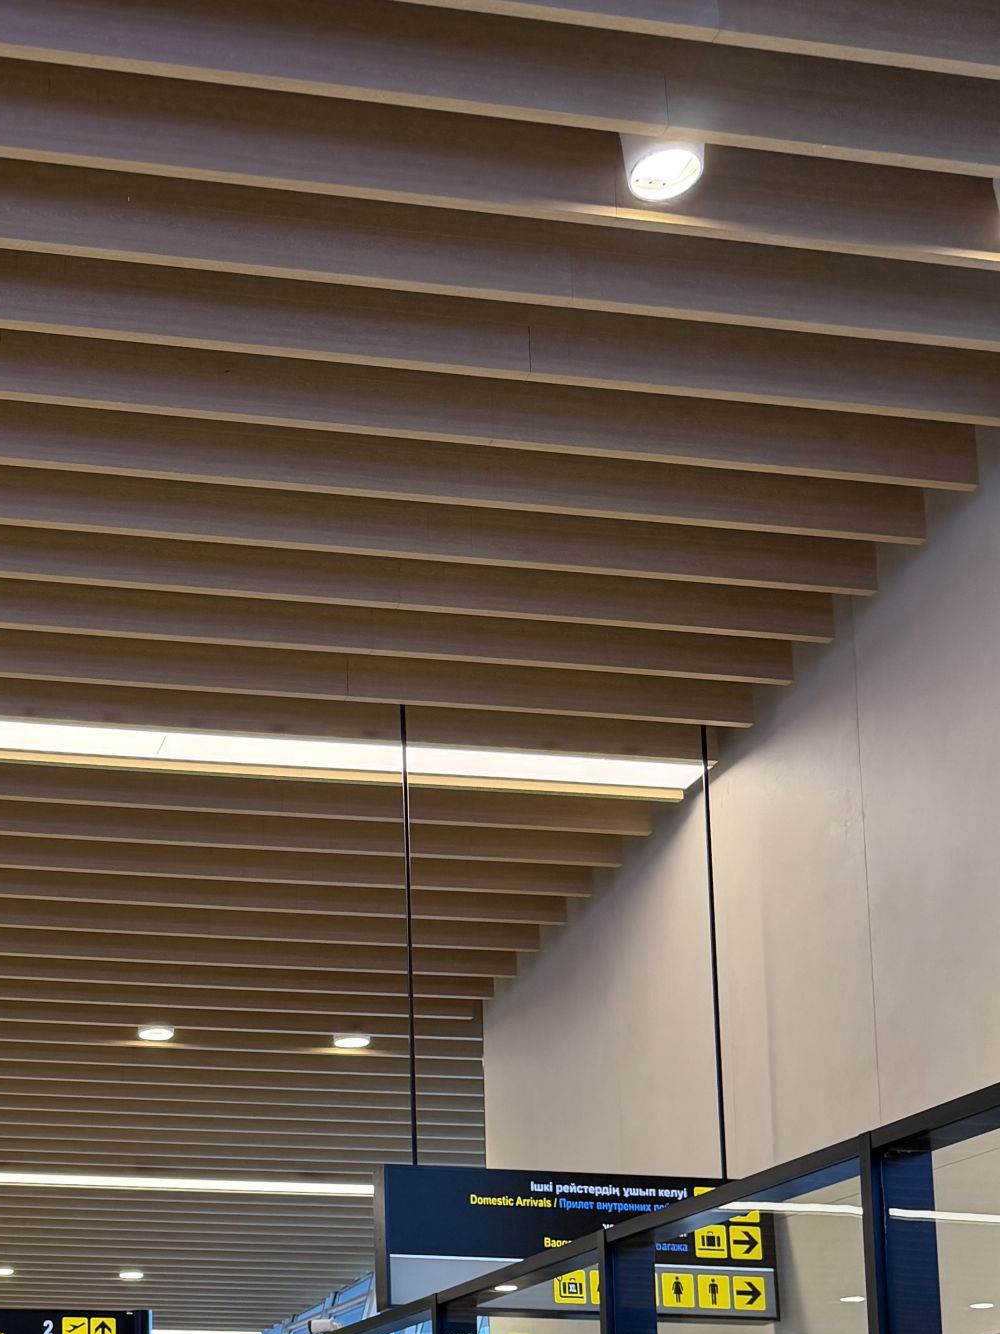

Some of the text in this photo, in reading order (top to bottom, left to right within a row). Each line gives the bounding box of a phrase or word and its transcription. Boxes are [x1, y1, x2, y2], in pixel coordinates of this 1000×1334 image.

[530, 1181, 553, 1192] Ішкі
[556, 1183, 620, 1196] рейстердің
[658, 1188, 687, 1200] келуі
[470, 1194, 514, 1206] Domestic
[516, 1196, 552, 1208] Arrivals
[559, 1198, 594, 1210] Прилет
[596, 1201, 652, 1212] внутренних
